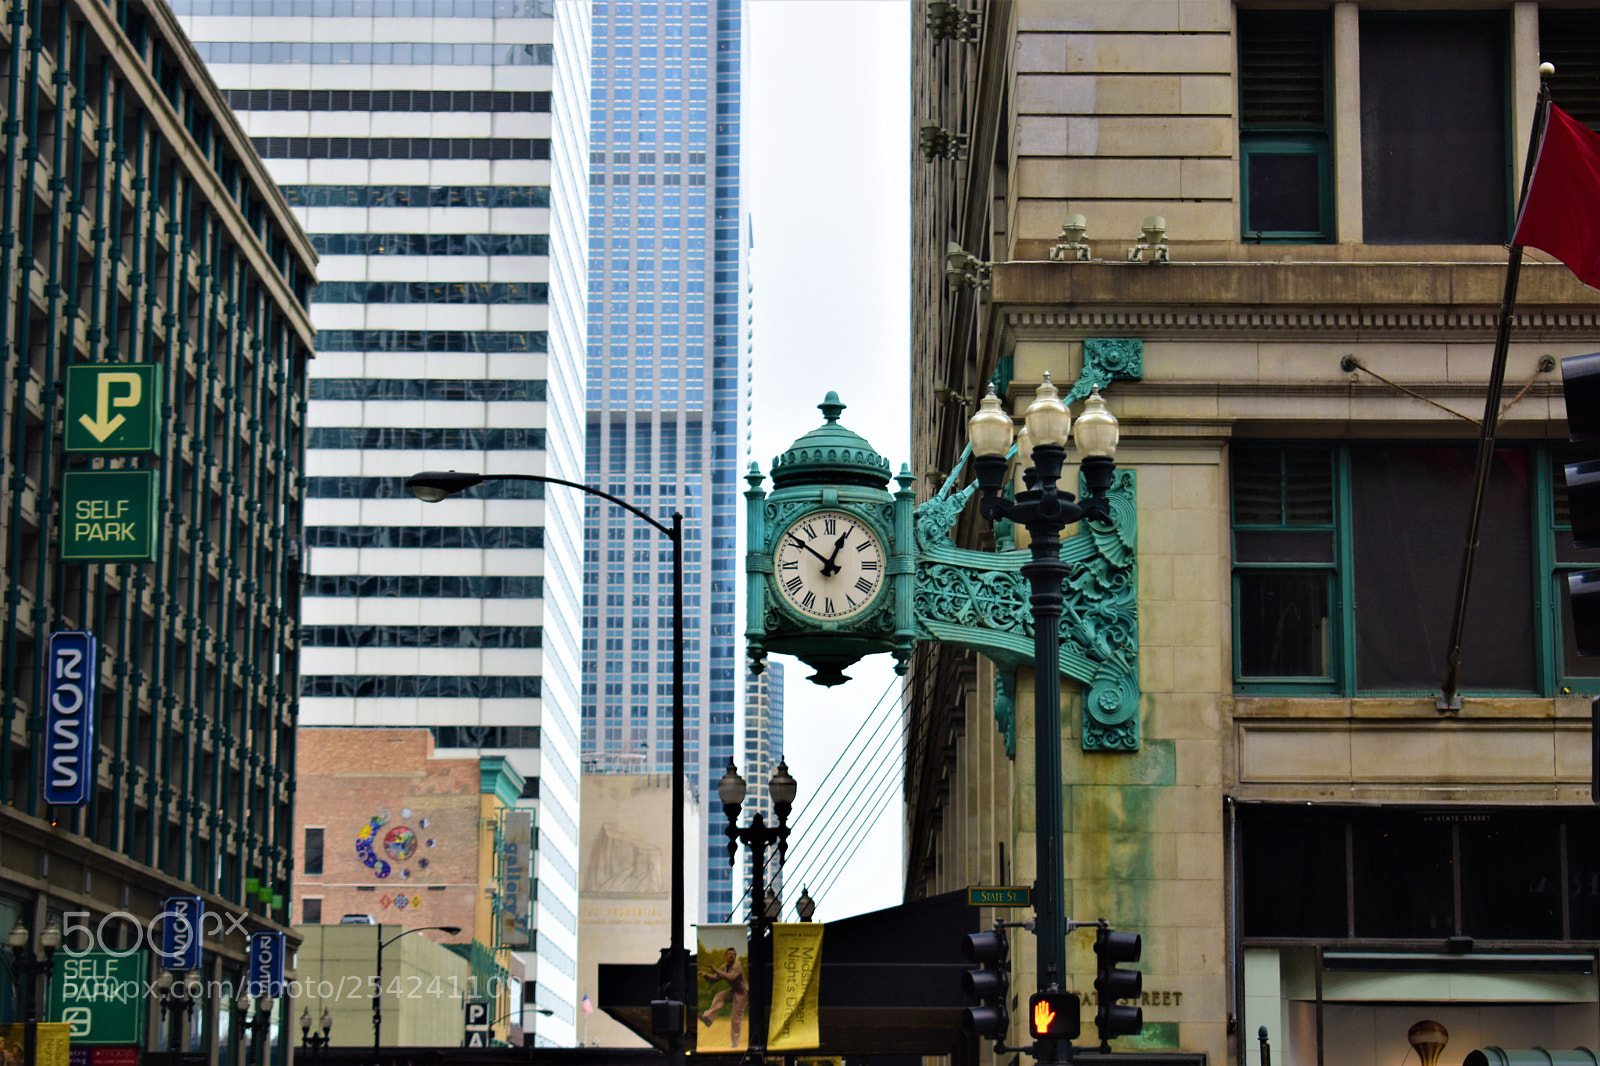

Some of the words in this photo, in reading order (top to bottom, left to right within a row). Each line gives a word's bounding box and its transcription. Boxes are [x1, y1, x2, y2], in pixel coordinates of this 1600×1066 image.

[75, 500, 130, 519] SELF
[75, 523, 136, 542] PARK
[52, 649, 82, 787] ROSS
[504, 843, 521, 914] gallery
[515, 914, 529, 935] 37
[173, 901, 188, 967] ROSS
[64, 960, 118, 979] SELF
[784, 946, 800, 993] Night's
[62, 983, 128, 1003] PARK
[782, 996, 798, 1039] Drem
